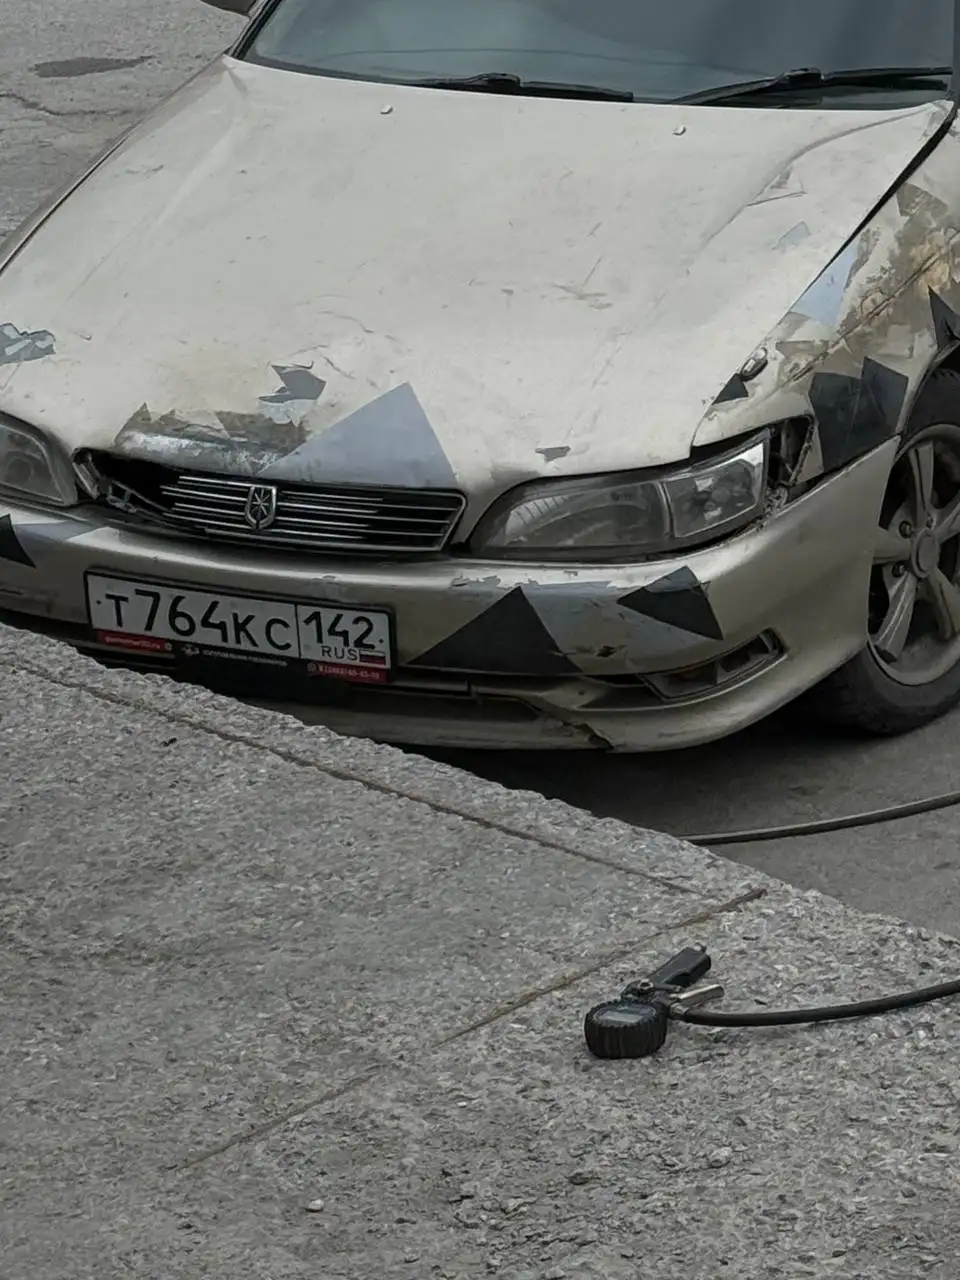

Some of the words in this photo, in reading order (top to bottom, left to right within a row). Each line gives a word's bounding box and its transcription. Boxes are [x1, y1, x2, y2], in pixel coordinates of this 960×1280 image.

[105, 588, 292, 652] Т764КС
[303, 611, 376, 650] 142
[321, 645, 358, 661] RUS
